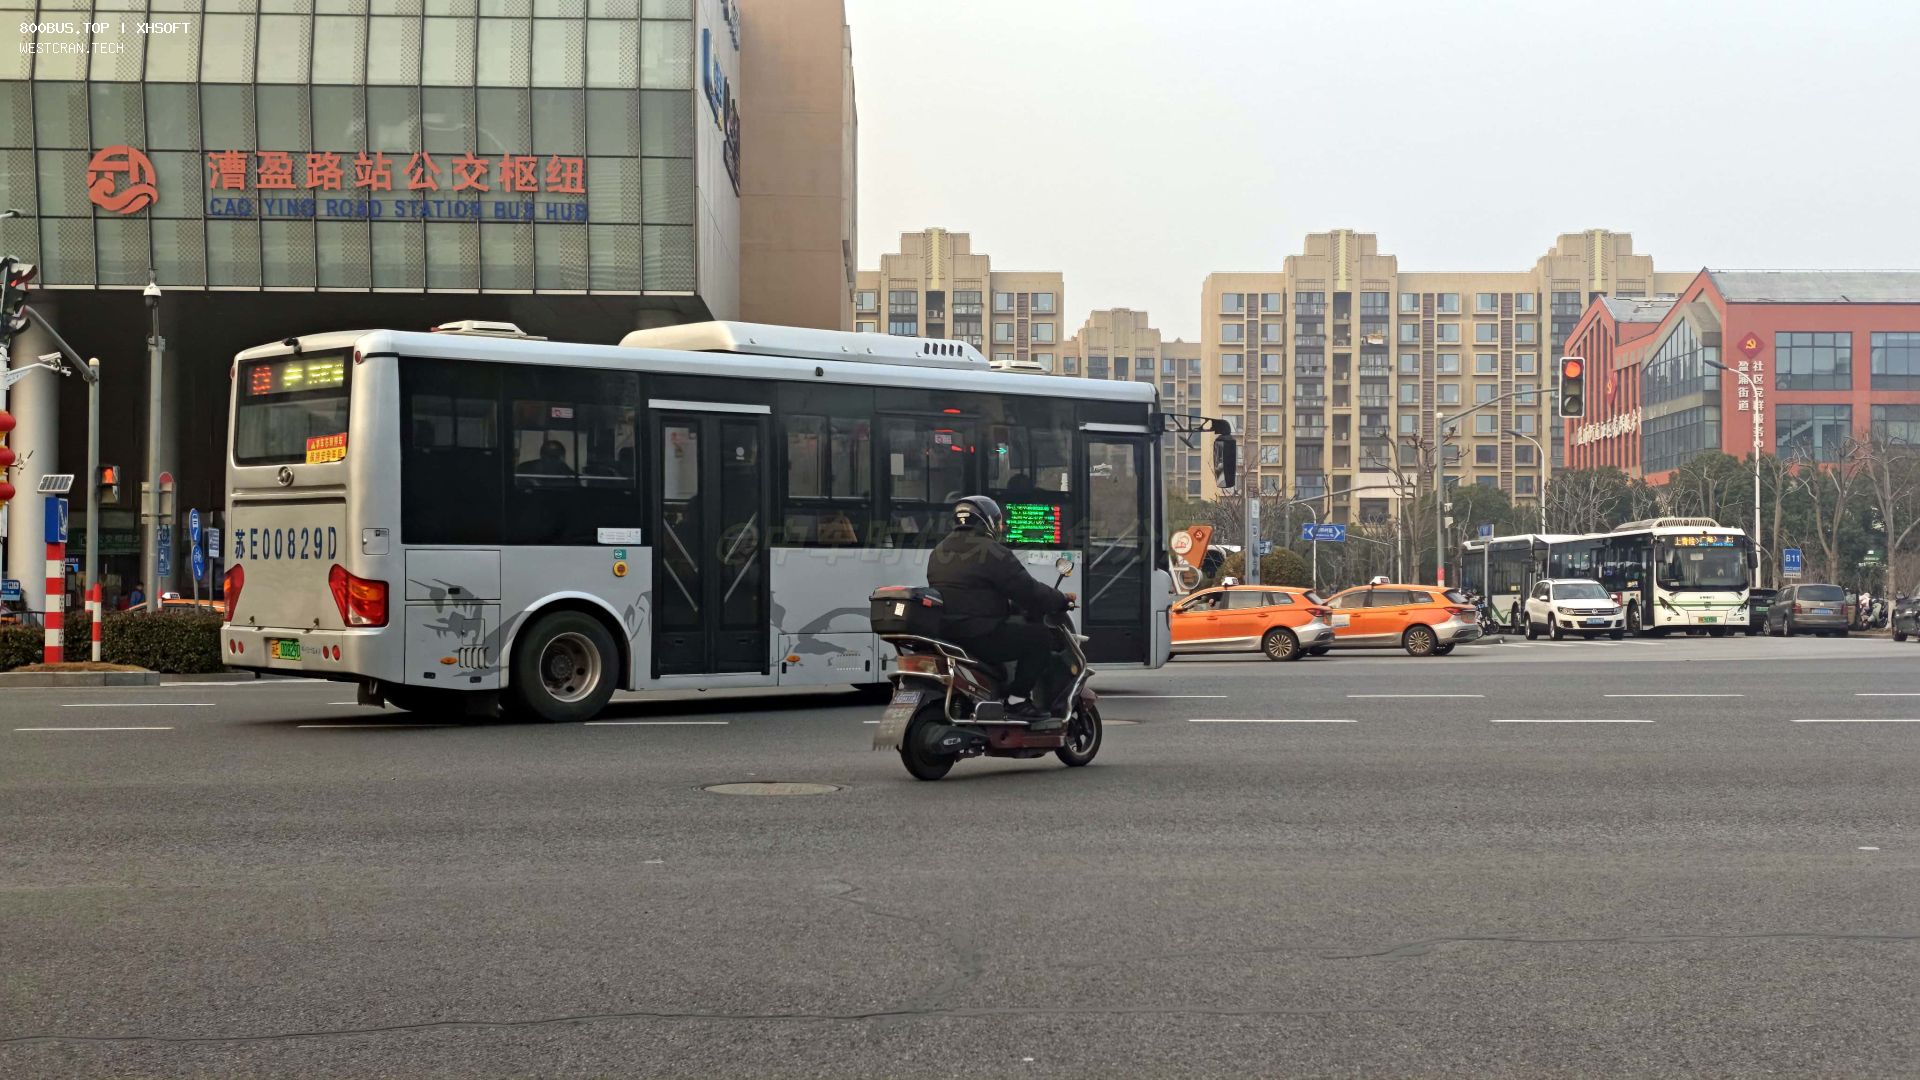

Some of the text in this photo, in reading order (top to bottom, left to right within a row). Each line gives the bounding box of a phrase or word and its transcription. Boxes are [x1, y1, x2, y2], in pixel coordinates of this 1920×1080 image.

[208, 150, 585, 193] 漕盈路站公交枢纽
[210, 198, 588, 221] CAO YING ROAD STATION BUS HUB
[235, 527, 337, 560] 苏E00829D
